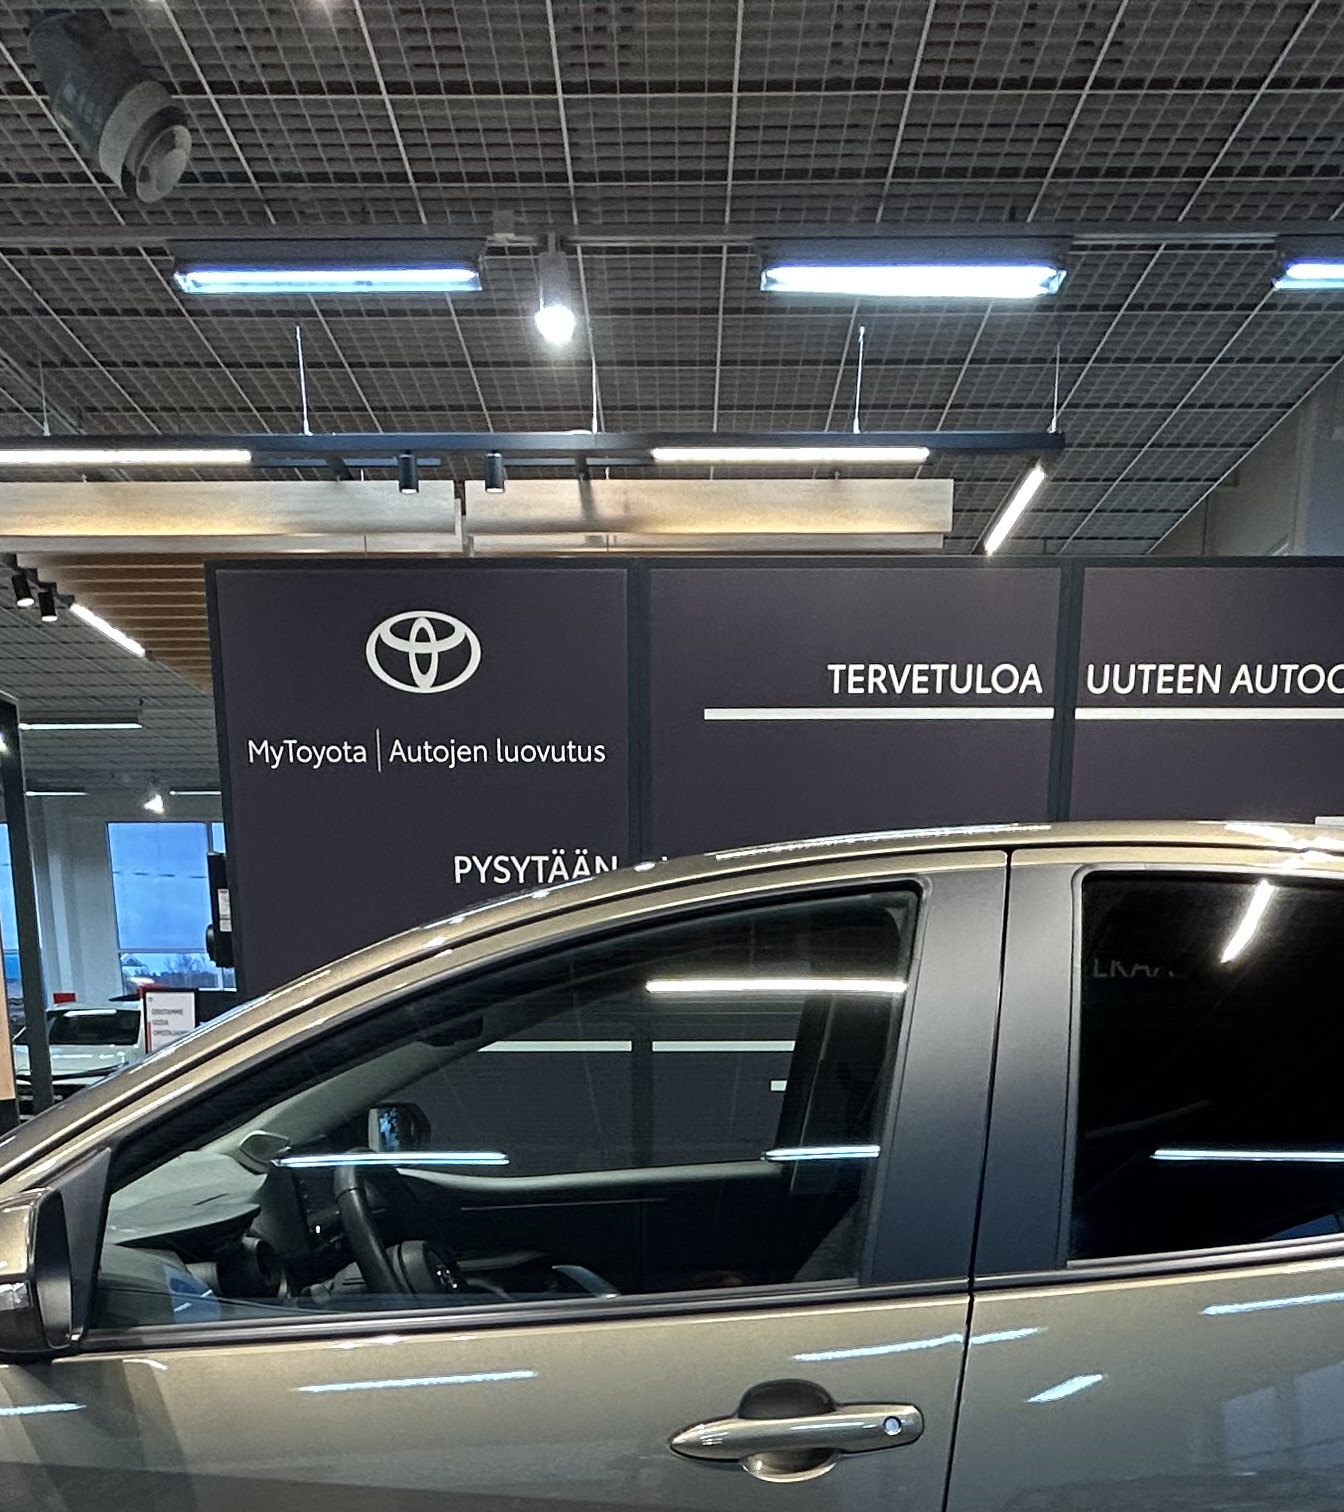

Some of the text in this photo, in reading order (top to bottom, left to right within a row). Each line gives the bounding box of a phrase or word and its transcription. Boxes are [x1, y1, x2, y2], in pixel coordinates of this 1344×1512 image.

[826, 663, 1043, 695] TERVETULOA
[1086, 663, 1222, 695] UUTEEN
[248, 737, 606, 770] MyToyota Autojen luovutus
[453, 848, 618, 885] PYSYTÄÄN
